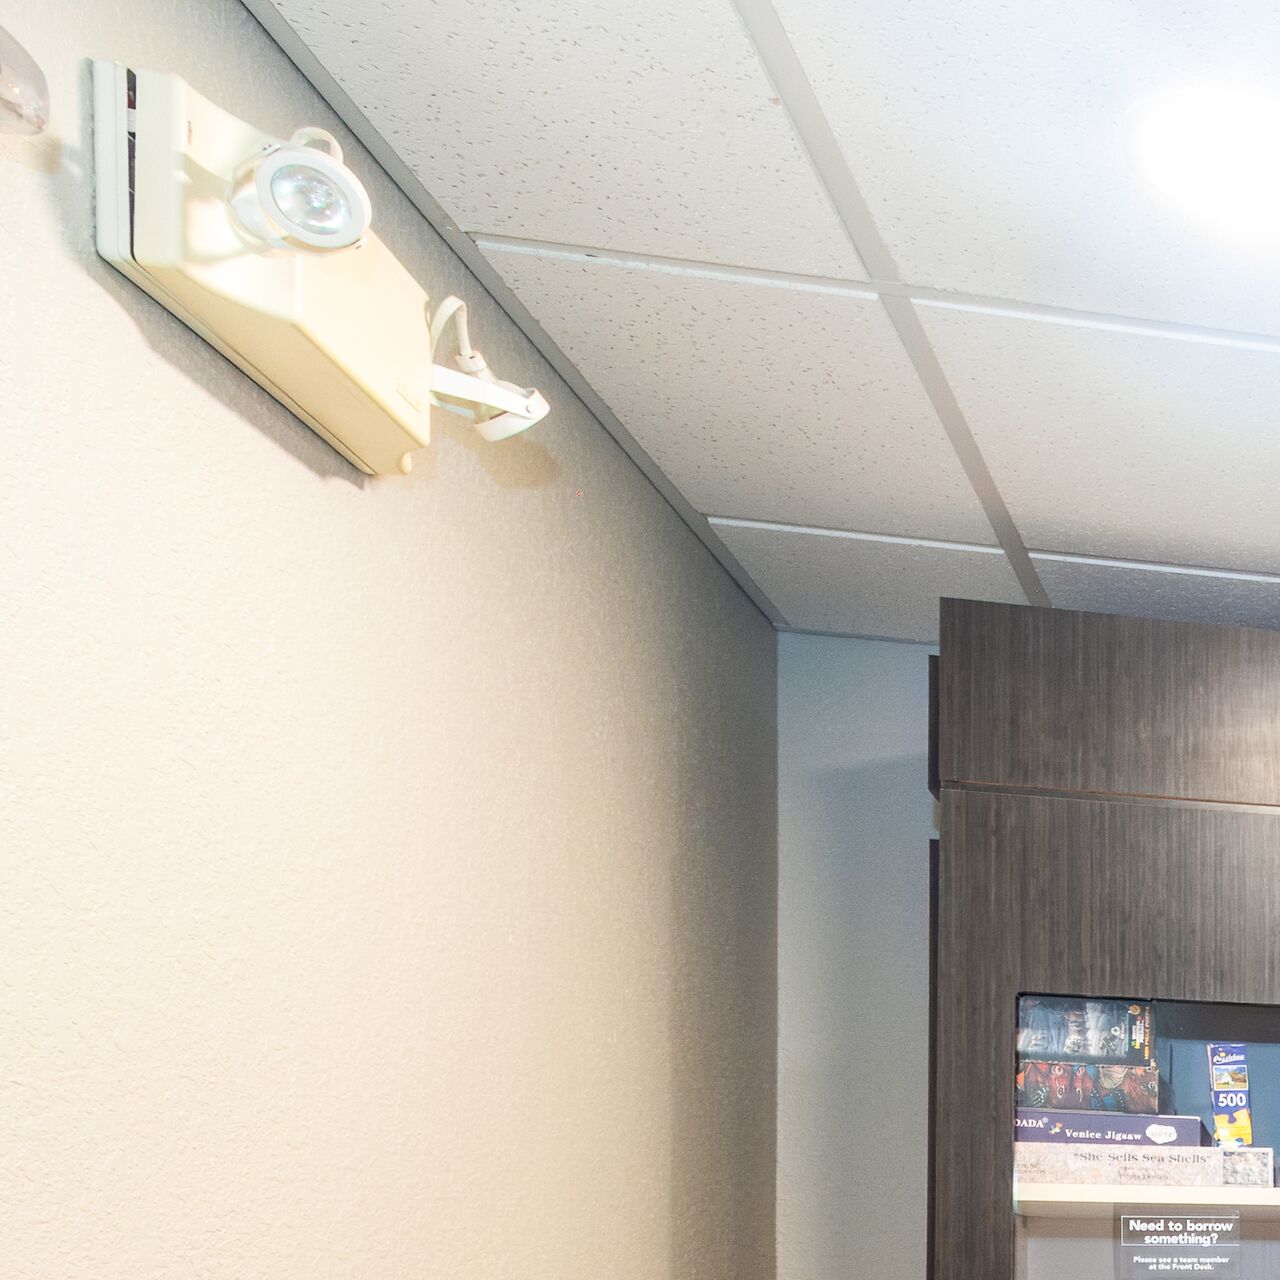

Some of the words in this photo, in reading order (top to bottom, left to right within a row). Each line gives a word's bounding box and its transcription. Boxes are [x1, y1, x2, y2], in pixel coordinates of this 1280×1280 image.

[1218, 1093, 1247, 1108] 500
[1064, 1129, 1102, 1140] Venice
[1104, 1130, 1143, 1142] Jigsaw
[1107, 1152, 1139, 1162] Sells
[1129, 1219, 1165, 1231] Need
[1168, 1220, 1183, 1231] to
[1186, 1219, 1234, 1231] borrow
[1144, 1232, 1219, 1247] something?
